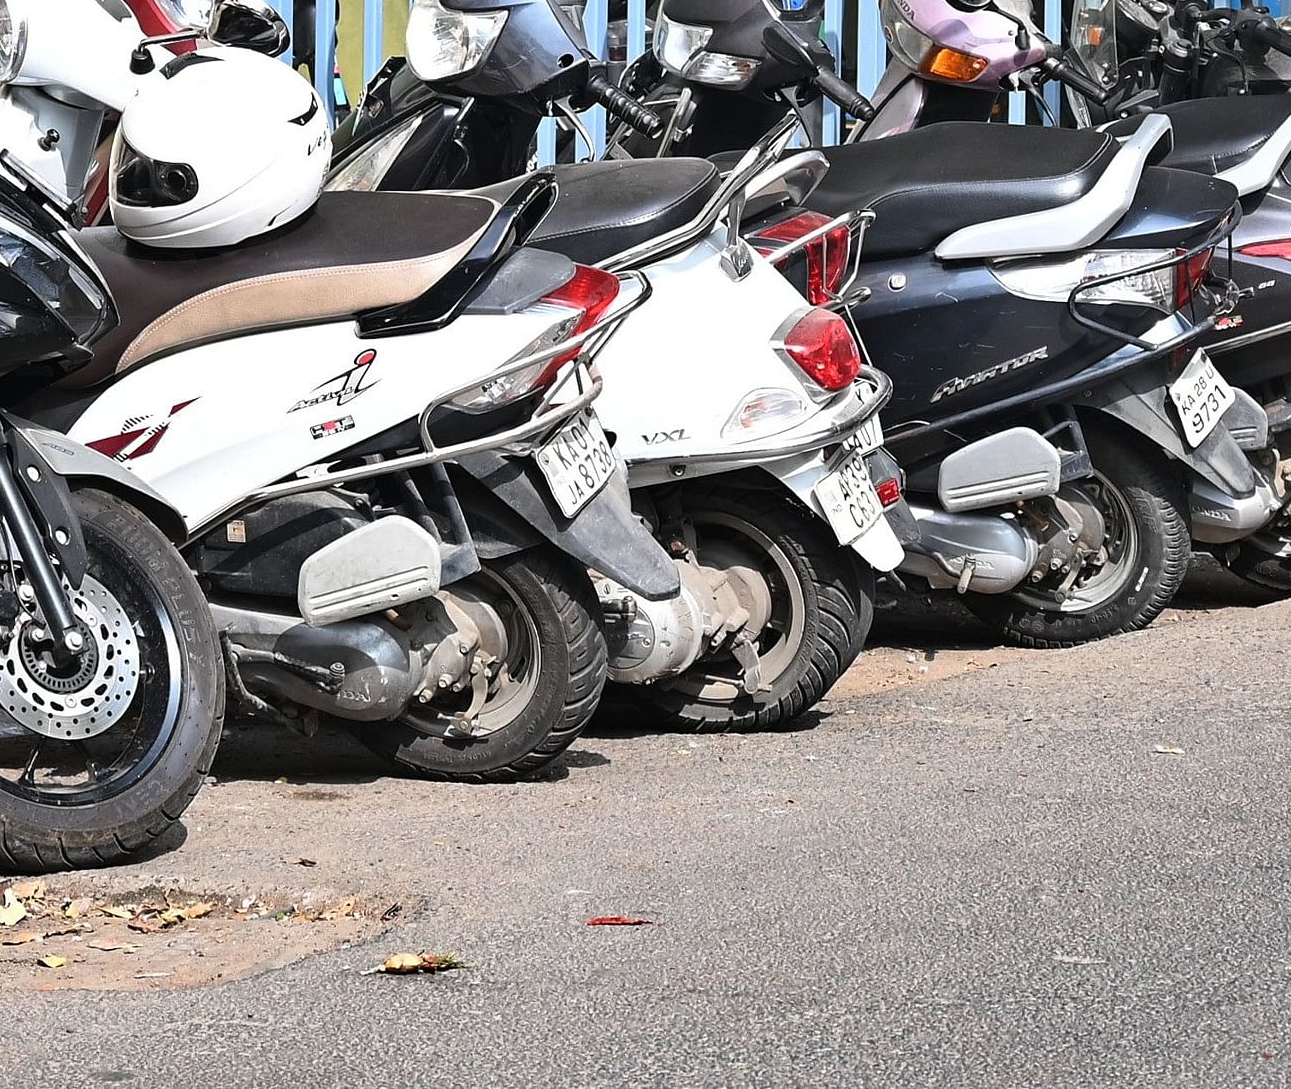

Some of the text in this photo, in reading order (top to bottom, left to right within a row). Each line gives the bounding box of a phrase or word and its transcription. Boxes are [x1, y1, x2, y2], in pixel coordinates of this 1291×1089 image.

[930, 345, 1049, 403] AVIATOR
[1192, 384, 1227, 434] 9731
[640, 428, 691, 446] VXL
[578, 440, 612, 489] 8738
